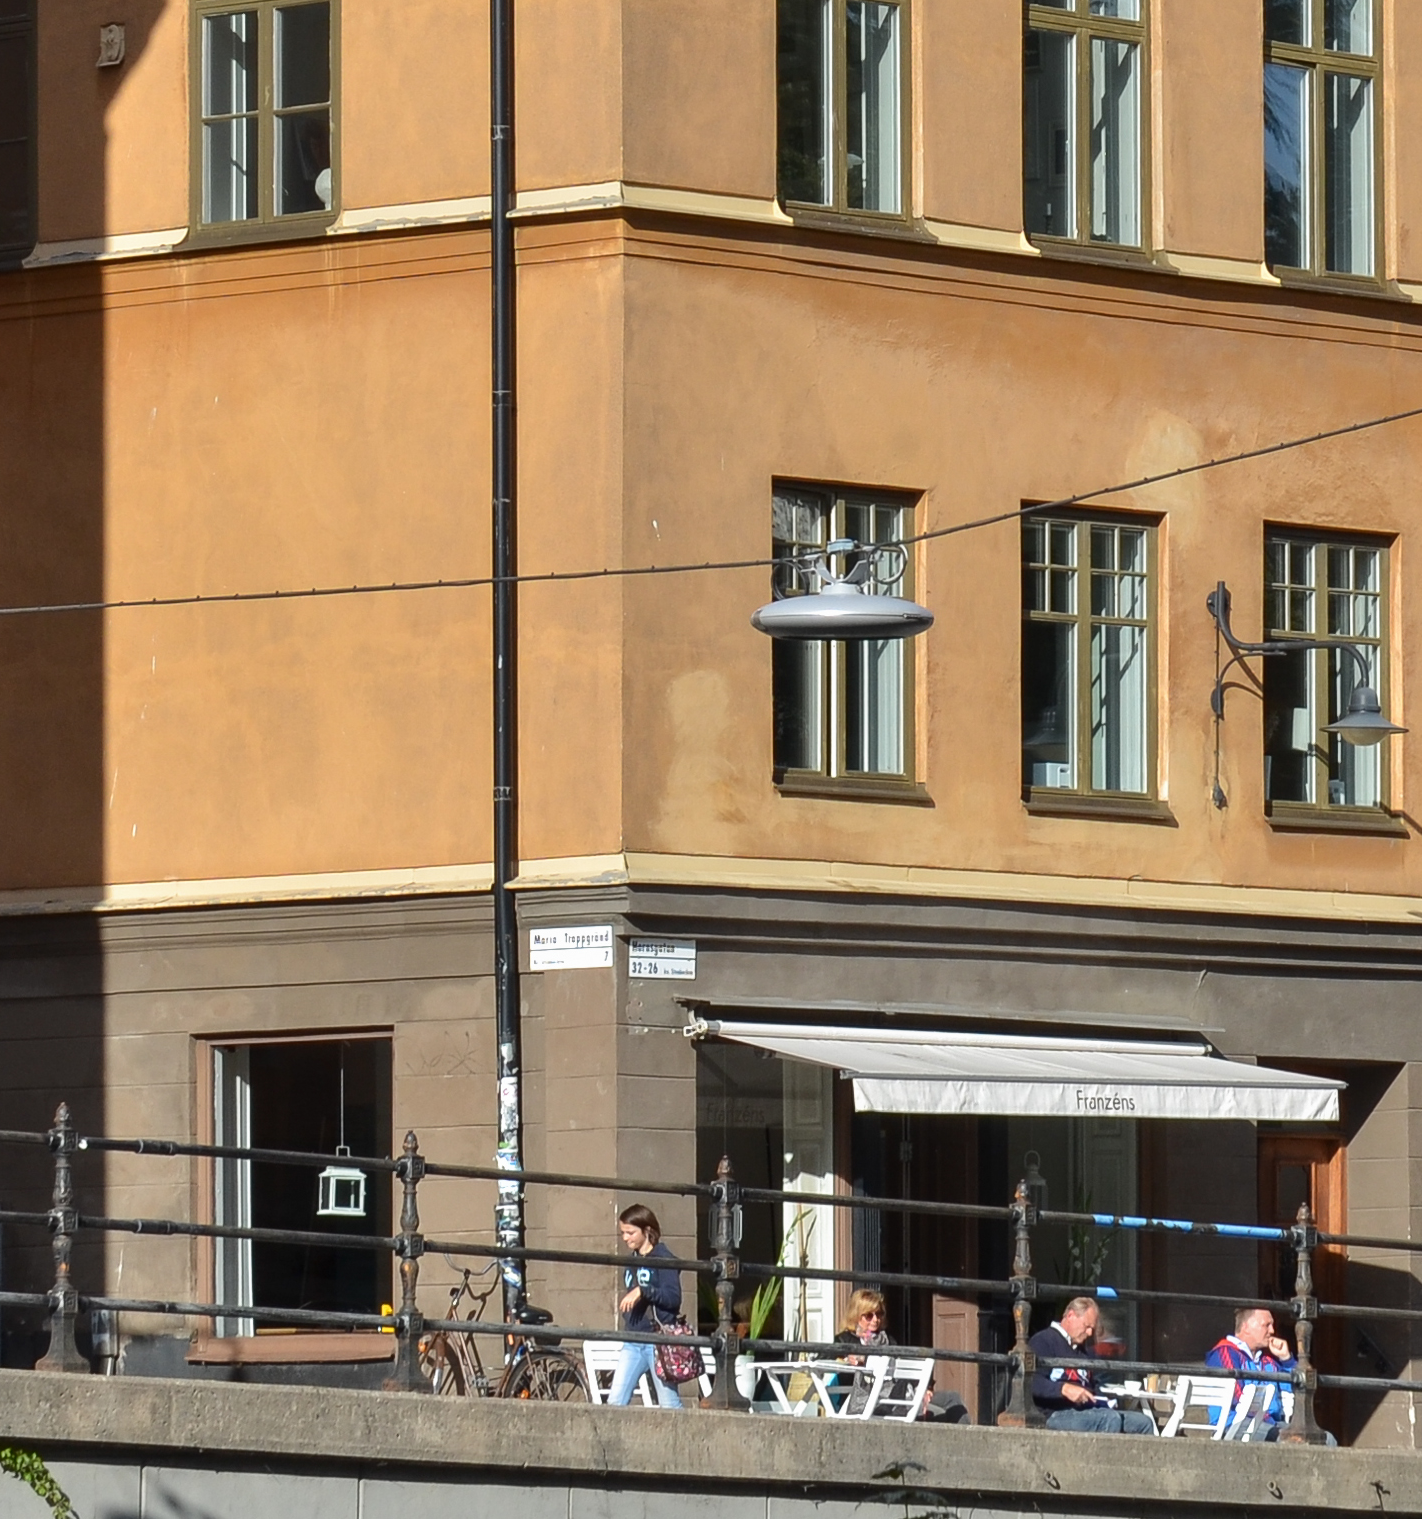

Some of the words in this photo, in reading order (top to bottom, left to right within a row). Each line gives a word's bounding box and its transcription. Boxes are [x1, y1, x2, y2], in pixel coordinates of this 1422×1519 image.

[533, 934, 557, 945] Maria
[631, 961, 659, 975] 32-26
[1076, 1089, 1136, 1111] Franzéns
